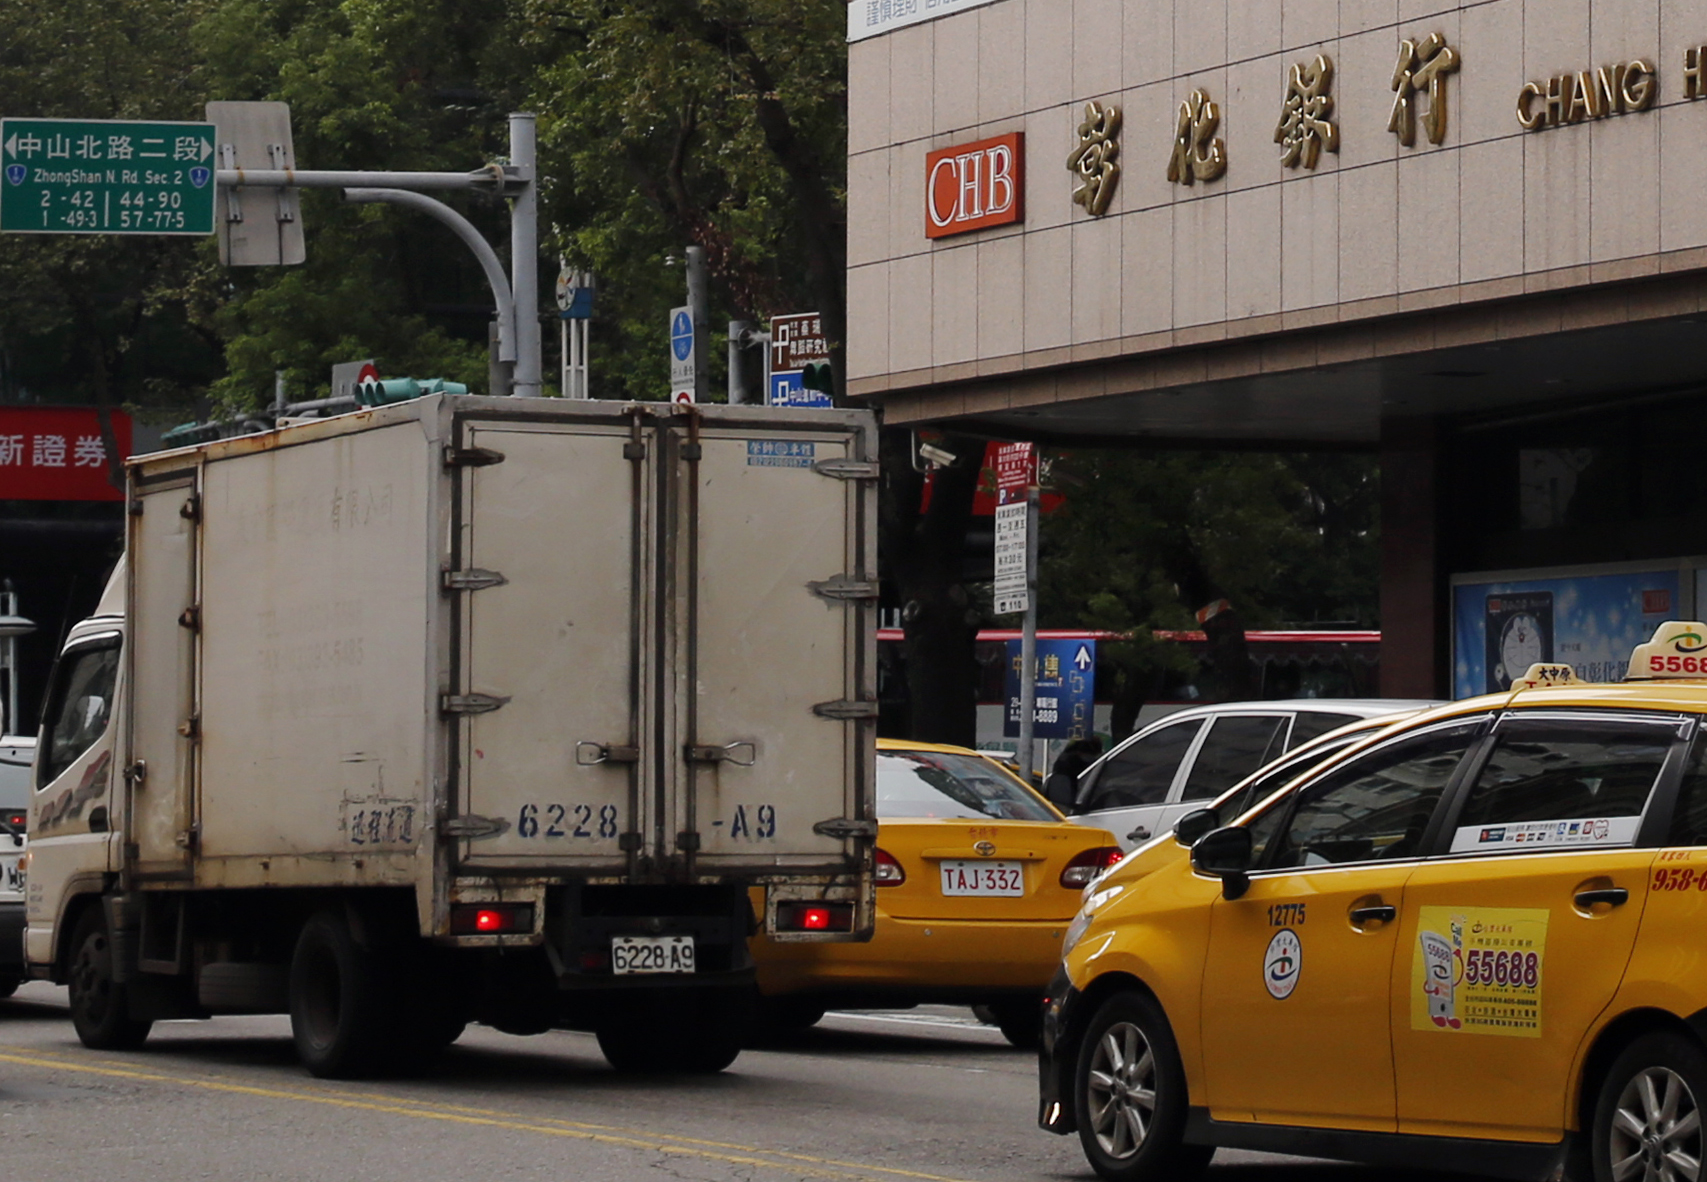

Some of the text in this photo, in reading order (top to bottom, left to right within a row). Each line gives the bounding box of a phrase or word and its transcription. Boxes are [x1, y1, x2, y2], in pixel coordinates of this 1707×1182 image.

[1516, 56, 1656, 131] CHANG
[1065, 31, 1462, 217] 彰化銀行
[18, 133, 201, 161] 中山北路二段
[34, 169, 182, 186] ZhongShan N. Rd. Sec. 2
[927, 140, 1014, 226] CHB
[0, 435, 107, 468] 新證券
[518, 804, 618, 839] 6228
[944, 868, 1021, 891] TAJ-332
[1268, 903, 1306, 926] 12775
[614, 944, 694, 971] 6228-A9
[1466, 949, 1538, 988] 55688
